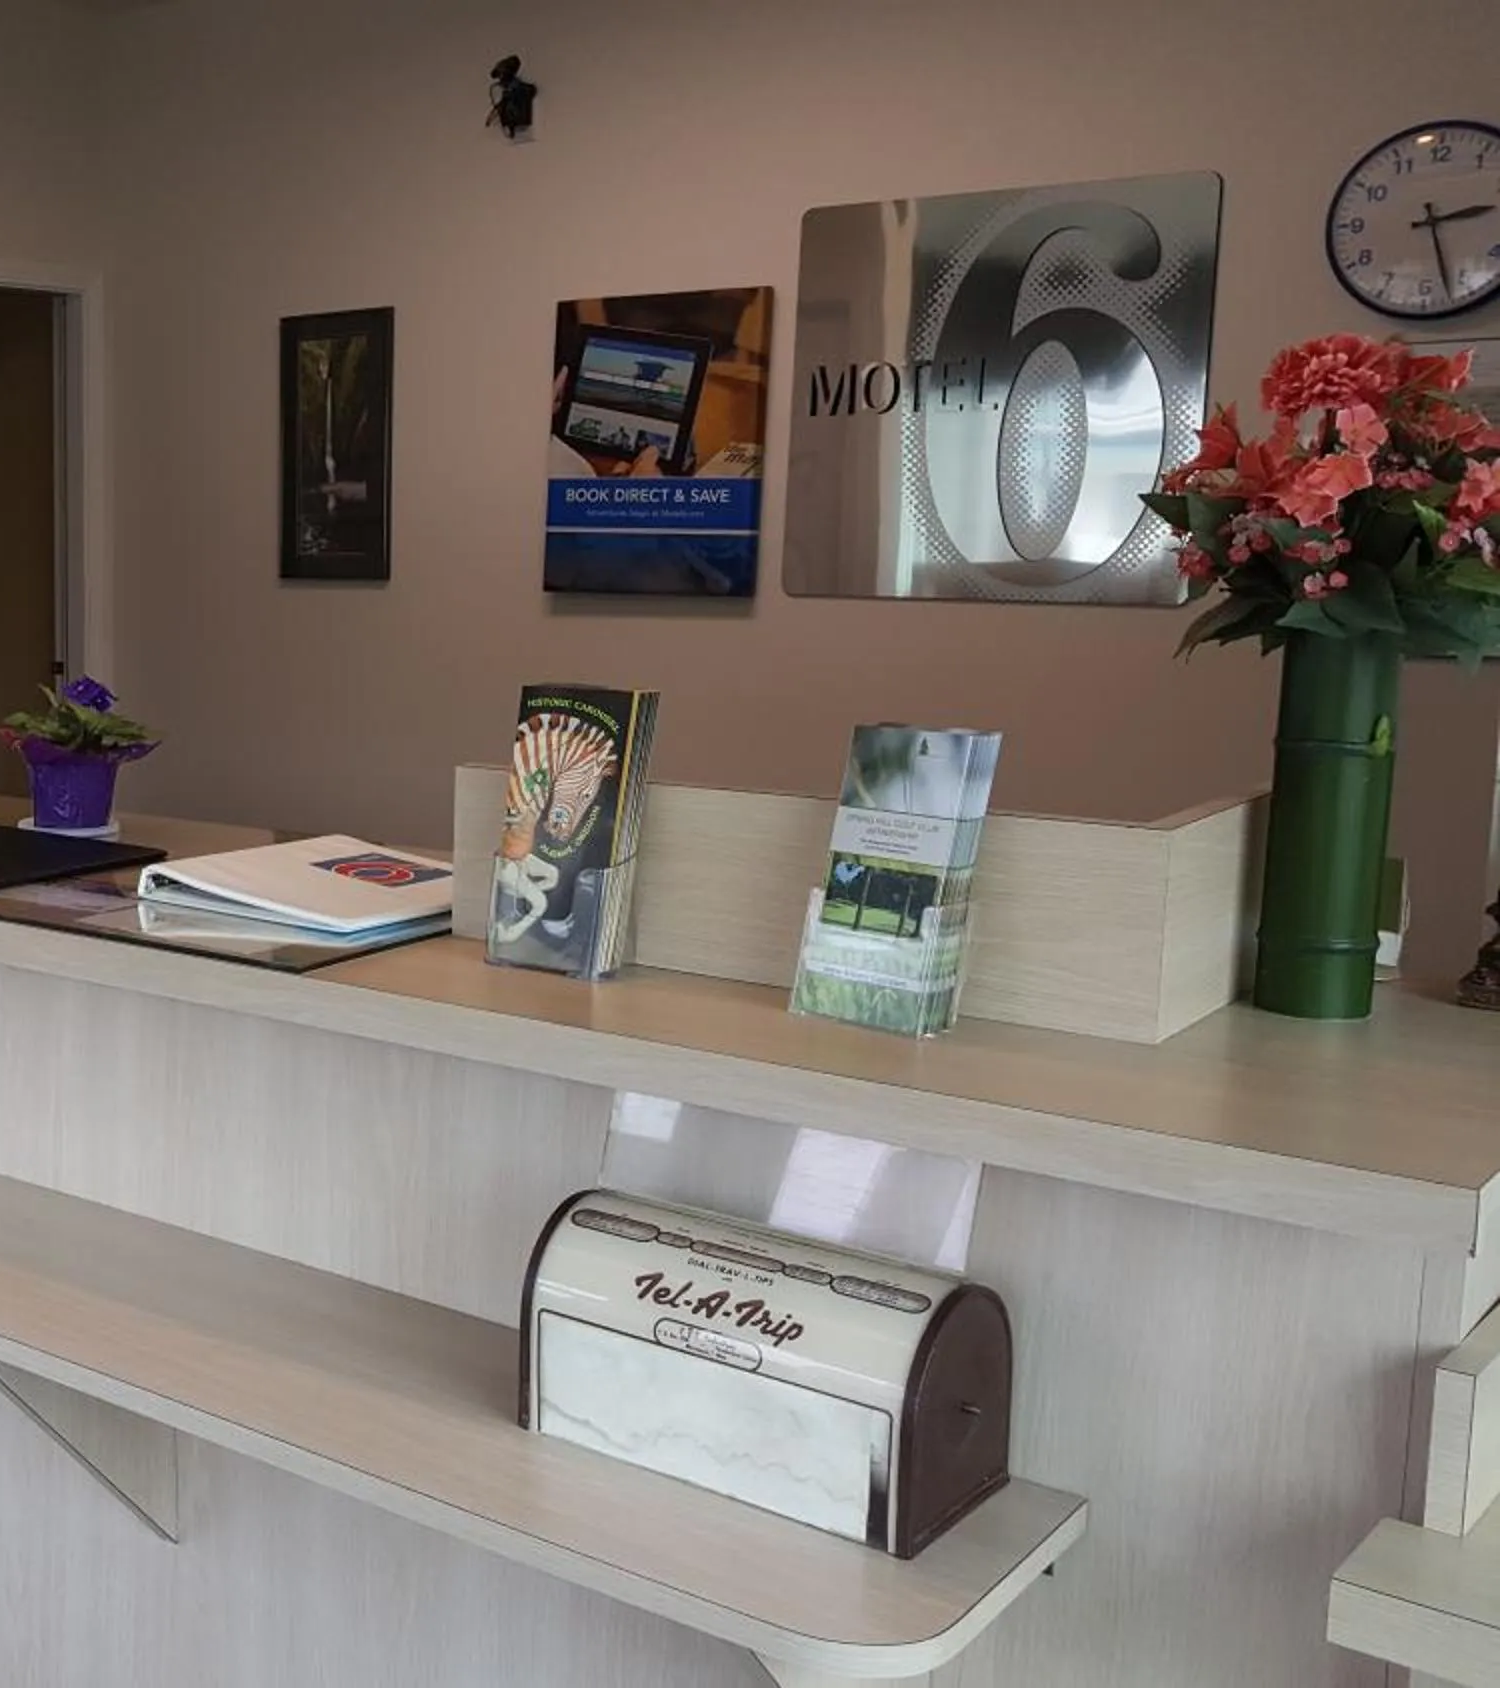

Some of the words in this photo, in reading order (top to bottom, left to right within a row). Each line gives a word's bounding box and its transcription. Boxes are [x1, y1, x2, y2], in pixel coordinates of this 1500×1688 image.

[1430, 145, 1452, 163] 12
[1476, 153, 1484, 169] 1
[1393, 159, 1414, 175] 11
[1367, 184, 1388, 202] 10
[1350, 217, 1365, 234] 9
[1358, 249, 1374, 266] 8
[1382, 271, 1396, 287] 7
[1418, 280, 1433, 296] 6
[809, 357, 1000, 417] MOTEL
[924, 200, 1167, 588] 6
[565, 488, 610, 503] BOOK
[614, 488, 669, 503] DIRECT
[673, 488, 686, 503] &
[690, 488, 732, 503] SAVE
[527, 698, 573, 708] HISTORIC
[634, 1273, 805, 1348] Tel-A-Trip
